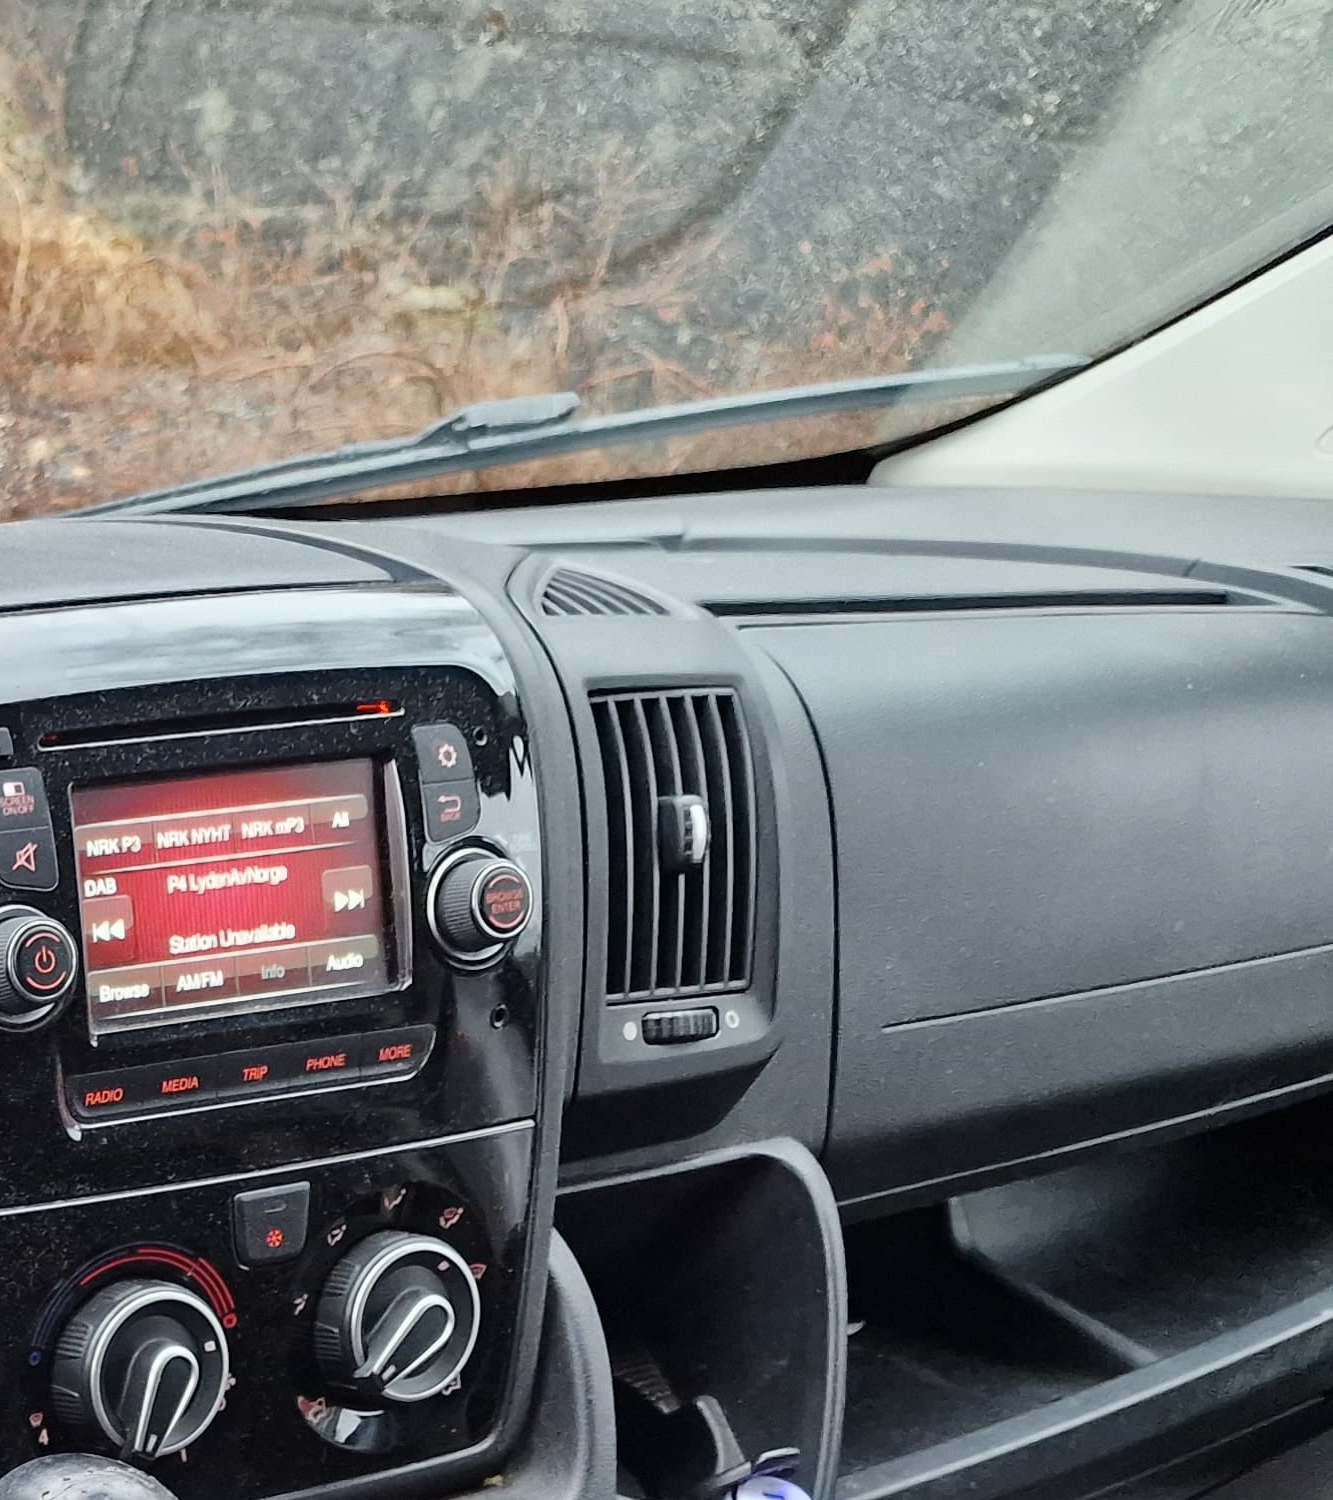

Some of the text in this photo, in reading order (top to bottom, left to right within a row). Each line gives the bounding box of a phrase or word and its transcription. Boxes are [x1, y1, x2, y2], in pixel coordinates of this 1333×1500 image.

[241, 816, 305, 839] NRK mP3
[332, 811, 350, 829] All
[86, 836, 141, 857] NRK P3
[157, 829, 190, 848] NRK
[84, 877, 117, 898] DAB
[167, 874, 187, 894] P4
[169, 921, 296, 955] Station Unavailable
[326, 951, 364, 972] Audio
[176, 970, 224, 992] AM/FM
[261, 964, 286, 980] Info
[99, 983, 150, 1003] Browse
[378, 1043, 412, 1061] MORE
[305, 1053, 346, 1072] PHONE
[242, 1065, 269, 1082] TRIP
[161, 1076, 199, 1094] MEDIA
[85, 1087, 124, 1107] RADIO
